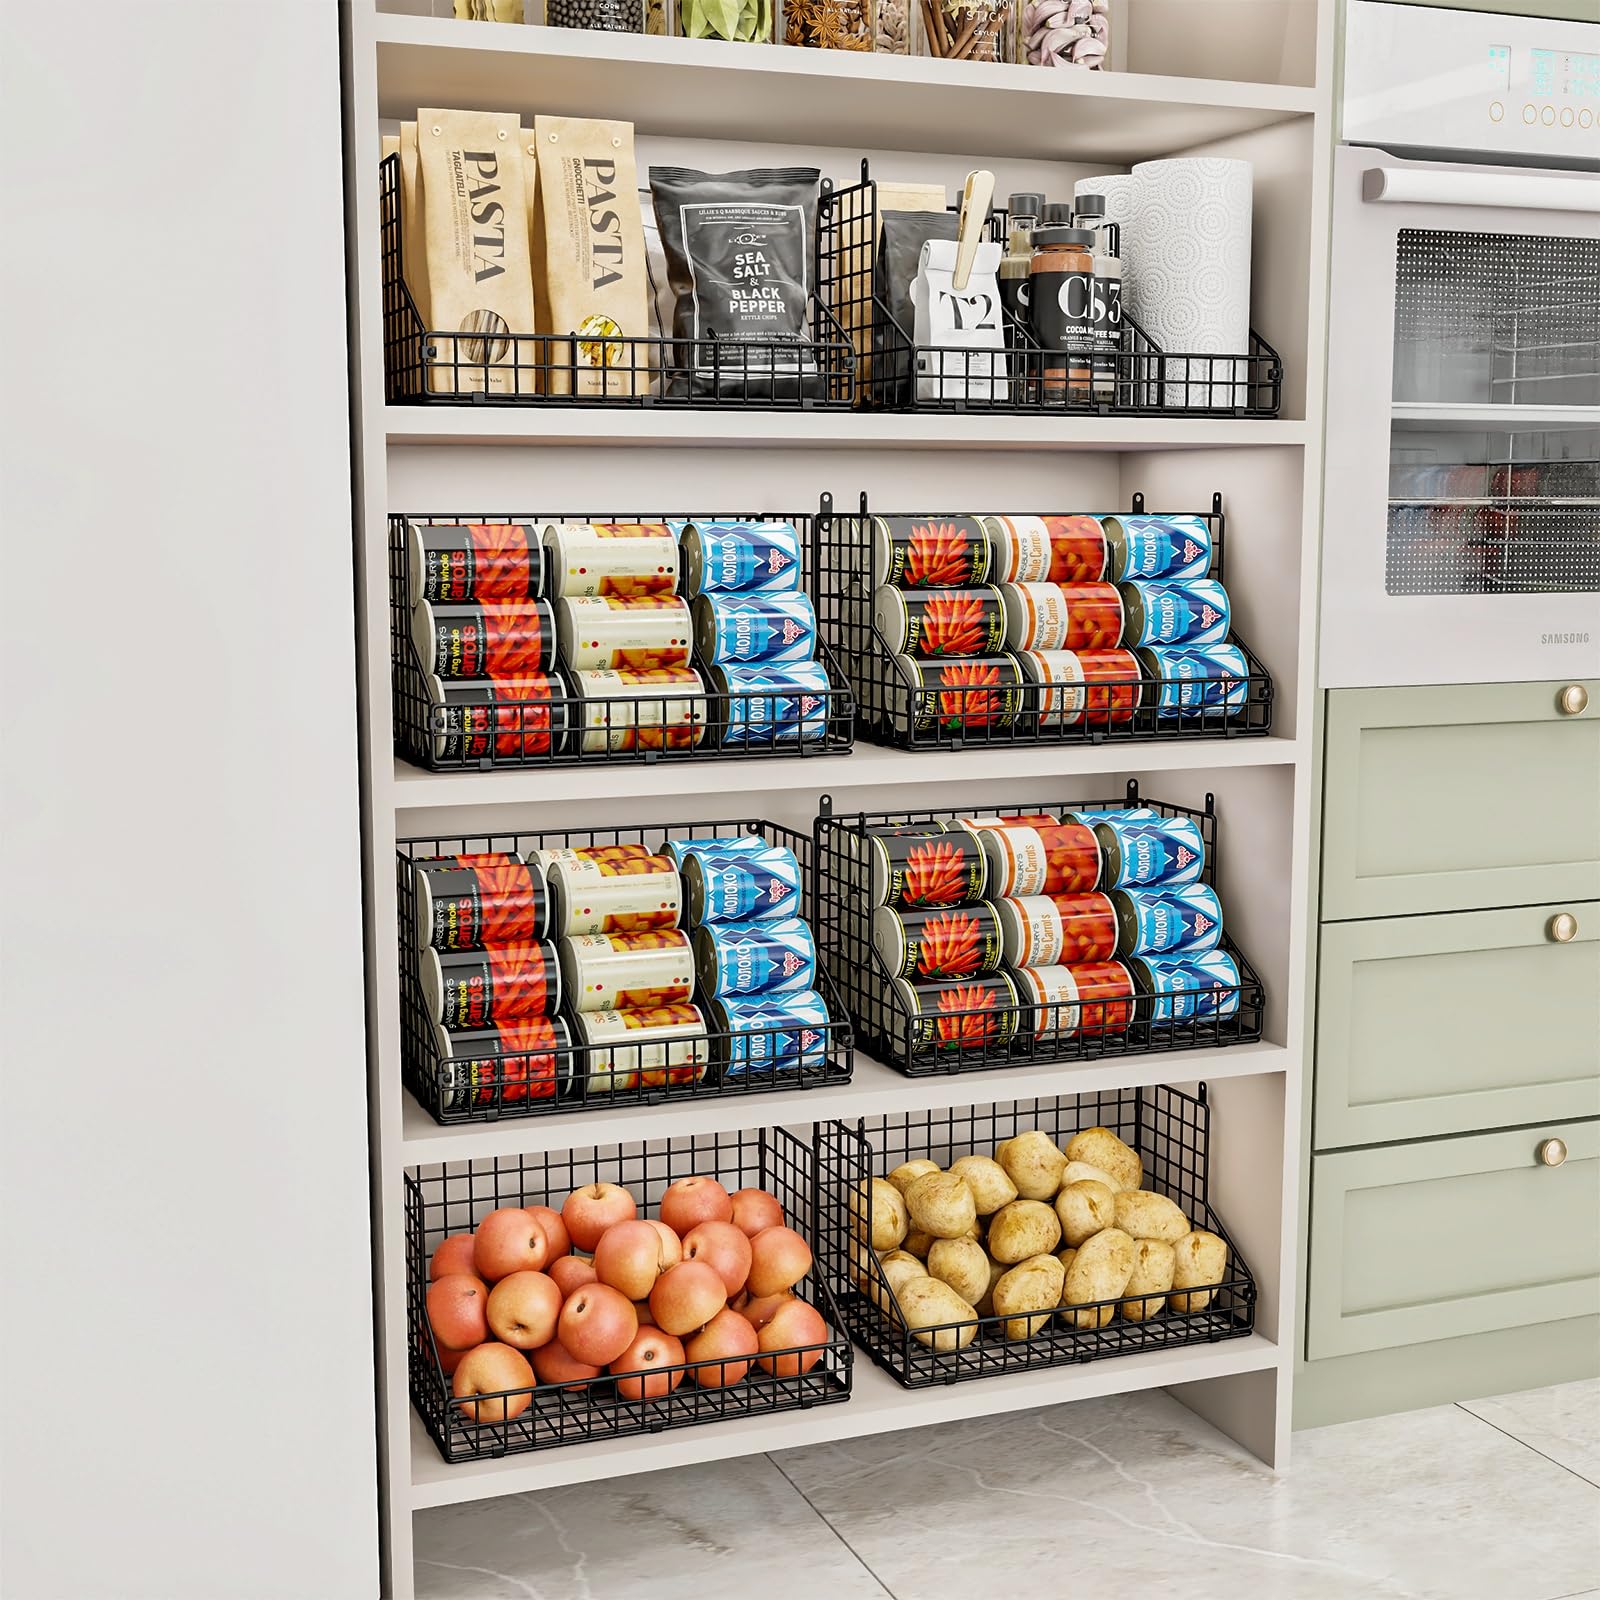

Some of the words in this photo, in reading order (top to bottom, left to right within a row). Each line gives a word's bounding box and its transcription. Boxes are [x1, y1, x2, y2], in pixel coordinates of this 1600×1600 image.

[967, 10, 1004, 24] STICK
[452, 150, 466, 198] TAGLIATELLI
[573, 158, 585, 204] GNOCCHETTI
[463, 150, 506, 285] PASTA
[583, 156, 624, 292] PASTA
[733, 264, 771, 279] SALT
[735, 251, 766, 266] SEA
[731, 287, 781, 300] BLACK
[750, 277, 760, 287] &
[729, 300, 786, 313] PEPPER
[939, 291, 996, 330] T2
[1065, 326, 1086, 334] COCOA
[721, 540, 737, 583] МОЛОКО
[1029, 528, 1042, 560] Carrots
[1142, 532, 1156, 571] МОЛОКО
[440, 553, 450, 581] whole
[450, 551, 466, 600] arrots
[1046, 597, 1058, 625] Carrots
[1160, 597, 1175, 637] МОЛОКО
[451, 628, 460, 657] whole
[735, 611, 751, 654] МОЛОКО
[461, 625, 477, 676] arrots
[1025, 845, 1037, 872] Carrots
[1136, 840, 1150, 878] МОЛОКО
[723, 873, 738, 914] МОЛОКО
[447, 902, 457, 929] whole
[1041, 914, 1053, 943] Carrots
[1153, 908, 1167, 946] МОЛОКО
[736, 945, 752, 988] МОЛОКО
[458, 980, 467, 1006] whole
